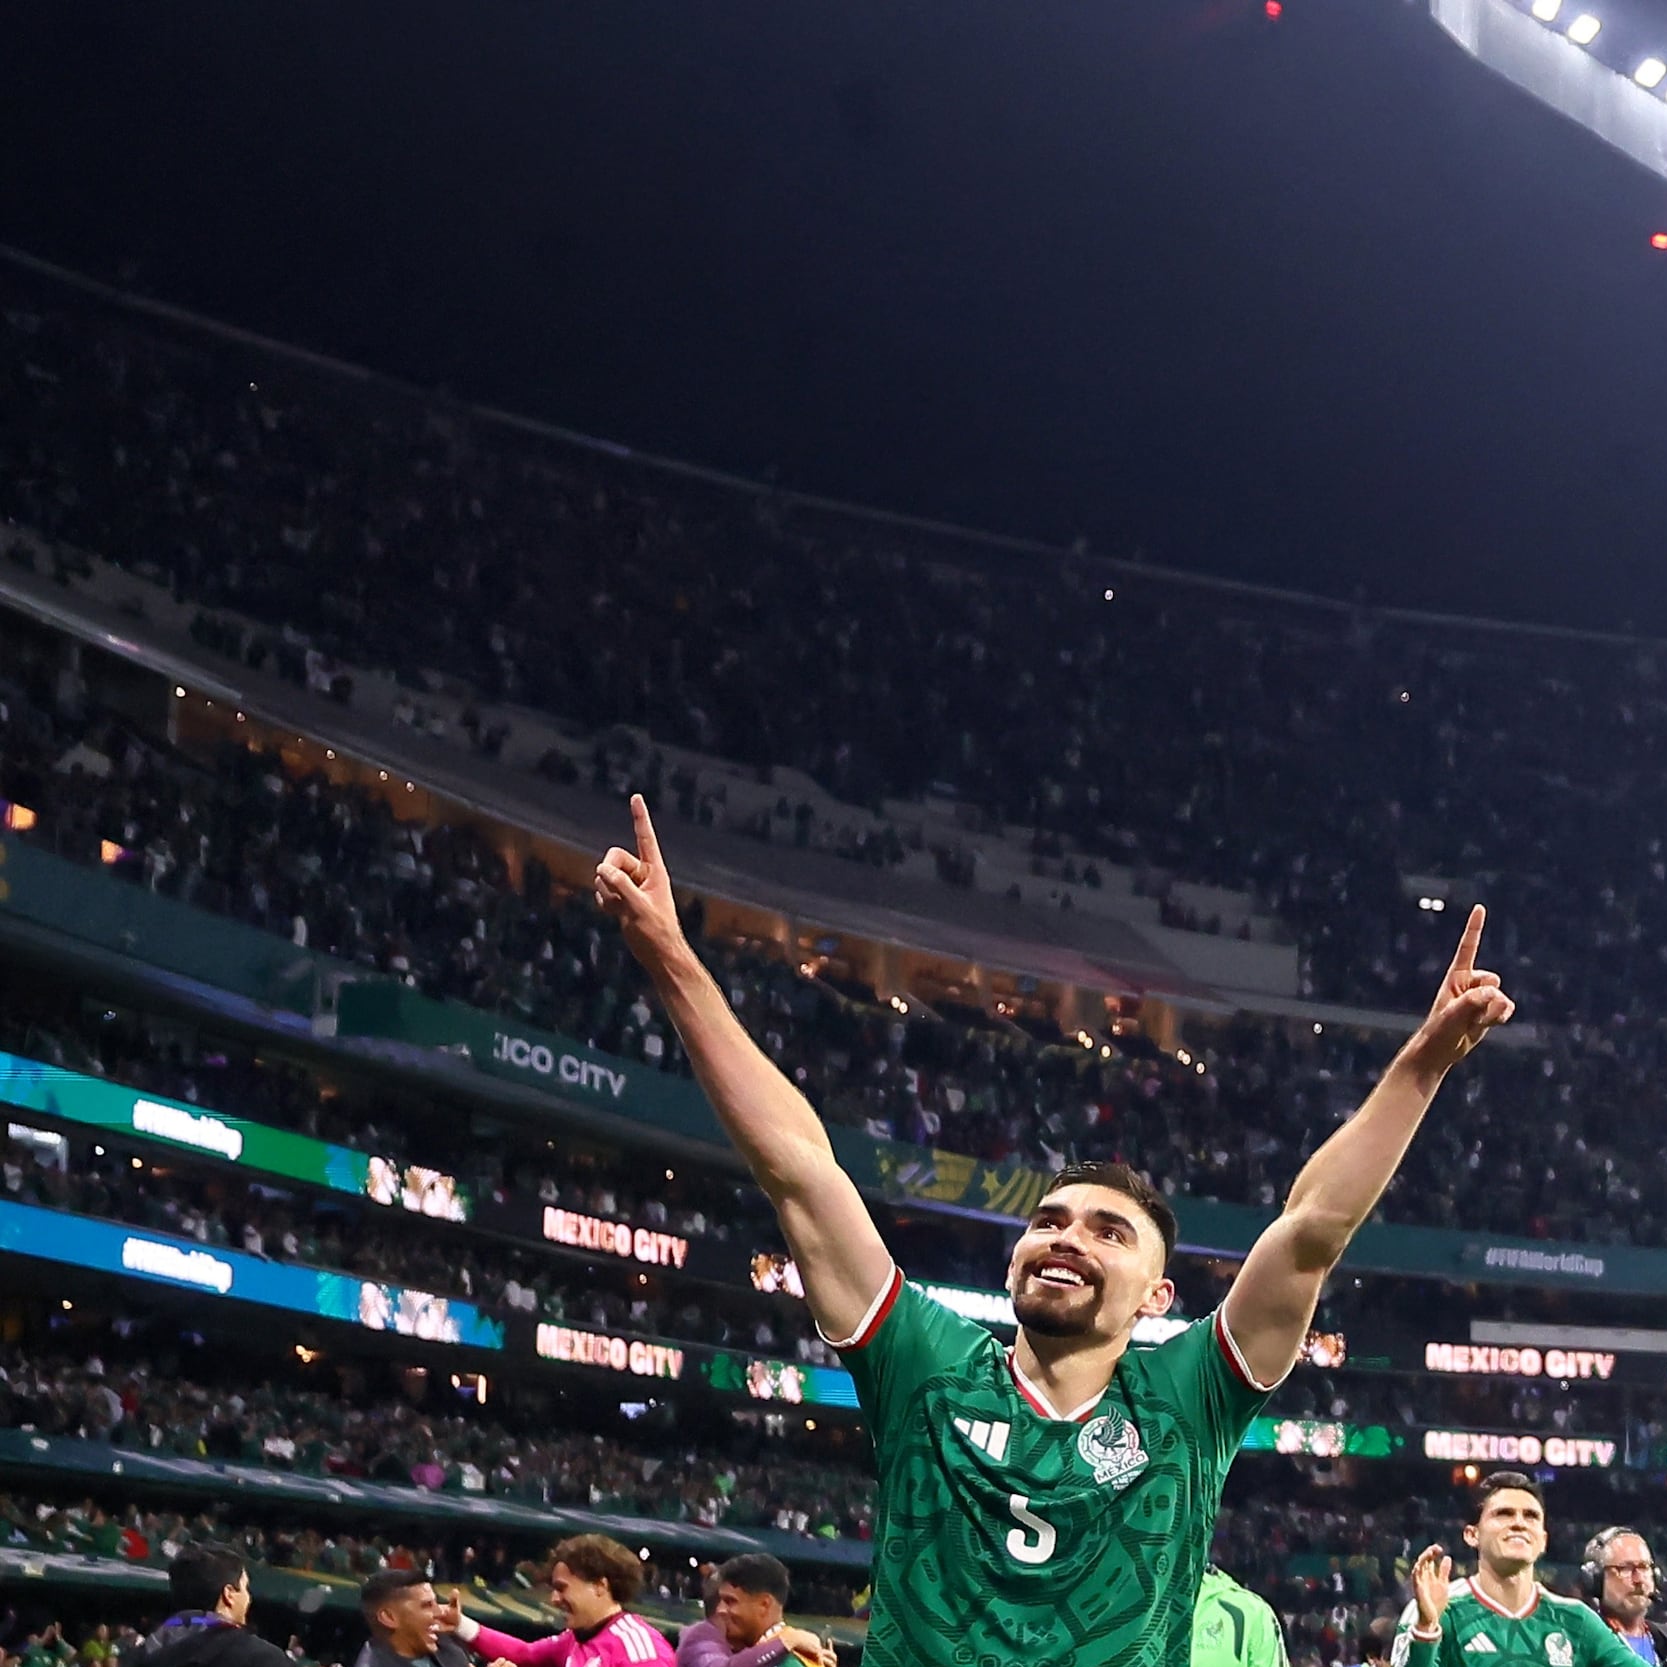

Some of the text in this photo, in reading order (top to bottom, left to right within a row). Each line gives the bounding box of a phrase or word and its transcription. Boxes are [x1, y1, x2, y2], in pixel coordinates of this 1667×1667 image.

[559, 1054, 626, 1098] CITY
[544, 1205, 689, 1270] MEXICO CITY
[536, 1322, 684, 1381] MEXICO CITY
[1425, 1342, 1615, 1379] MEXICO CITY
[1424, 1430, 1616, 1467] MEXICO CITY
[1006, 1494, 1056, 1564] 5
